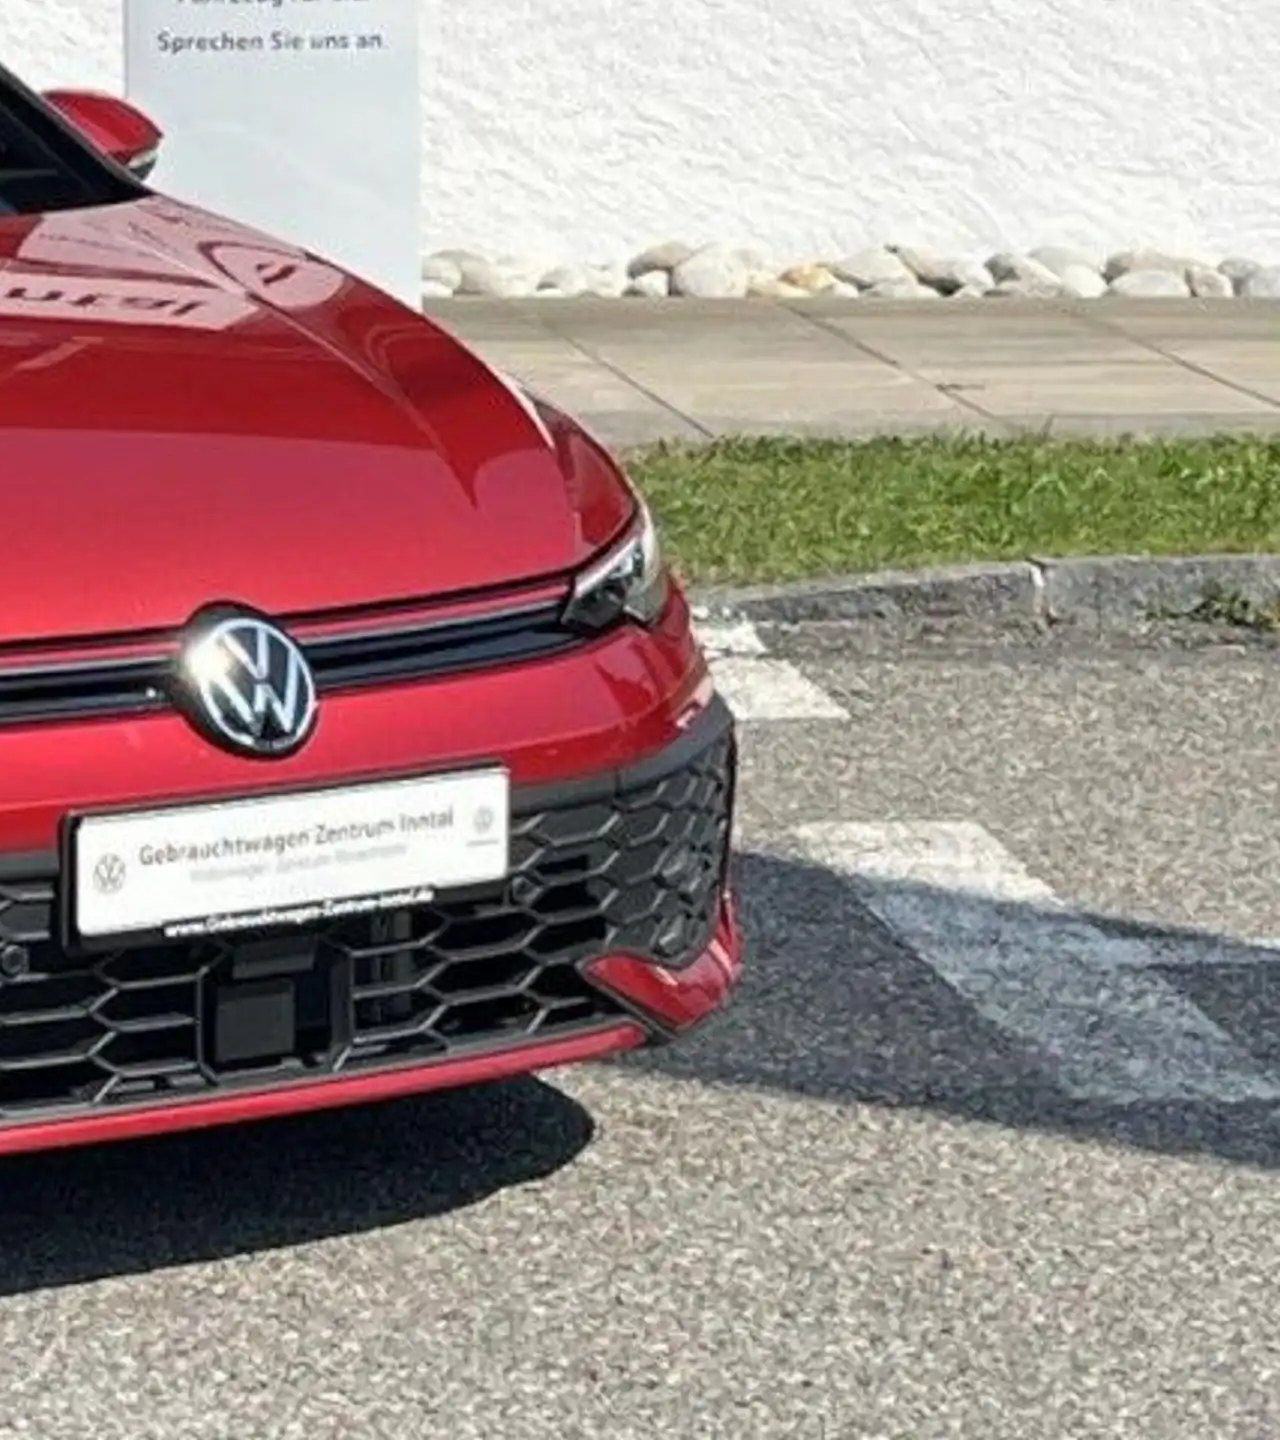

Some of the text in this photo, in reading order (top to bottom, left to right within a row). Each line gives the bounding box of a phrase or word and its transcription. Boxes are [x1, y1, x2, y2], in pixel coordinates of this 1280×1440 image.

[157, 31, 264, 56] Sprechen
[270, 31, 304, 51] Sie
[310, 35, 349, 51] uns
[138, 831, 312, 867] Gebrauchtwagen
[314, 818, 397, 847] Zentrum
[399, 806, 455, 832] Inntal
